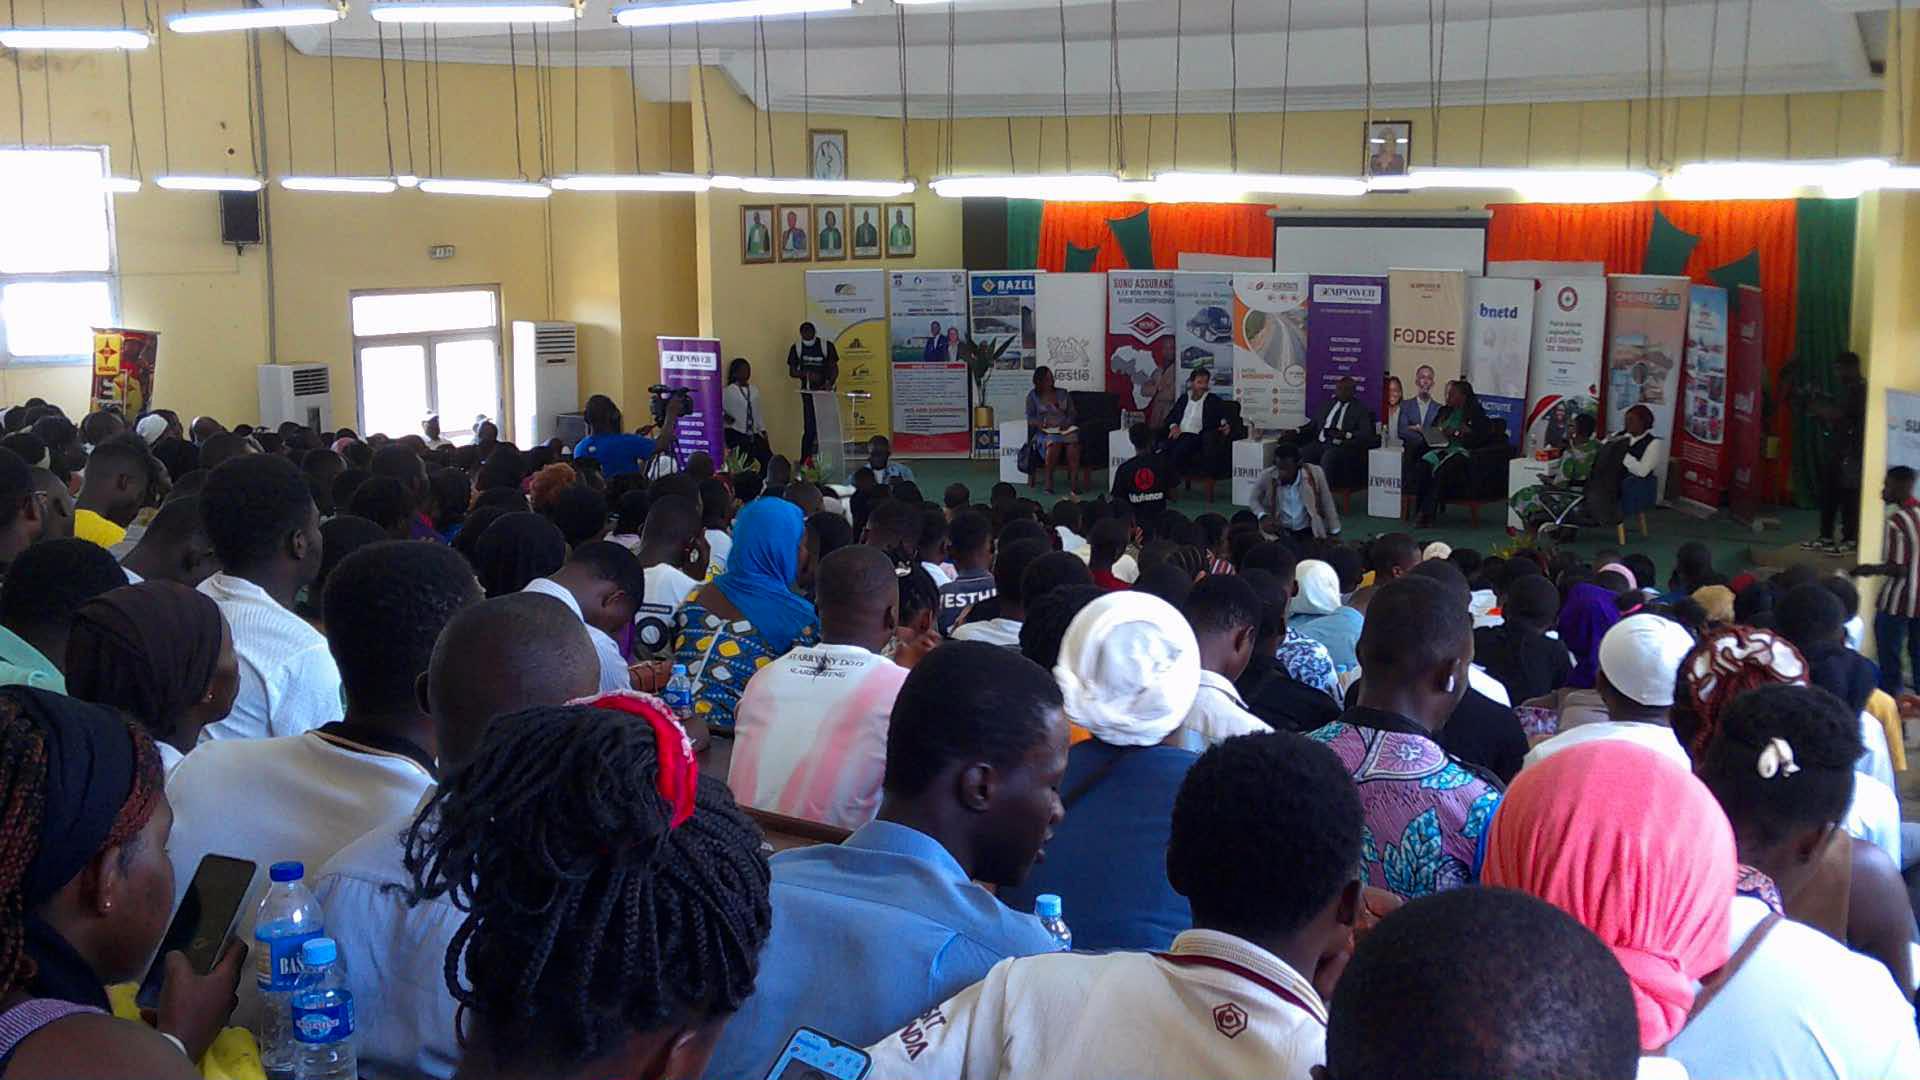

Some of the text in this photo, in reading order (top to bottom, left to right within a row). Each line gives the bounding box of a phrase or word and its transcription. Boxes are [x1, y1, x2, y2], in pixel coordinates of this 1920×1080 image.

[997, 280, 1034, 290] RAZEL
[1480, 303, 1518, 319] bnetd
[1393, 328, 1456, 346] FODESE
[1054, 368, 1090, 381] estlé
